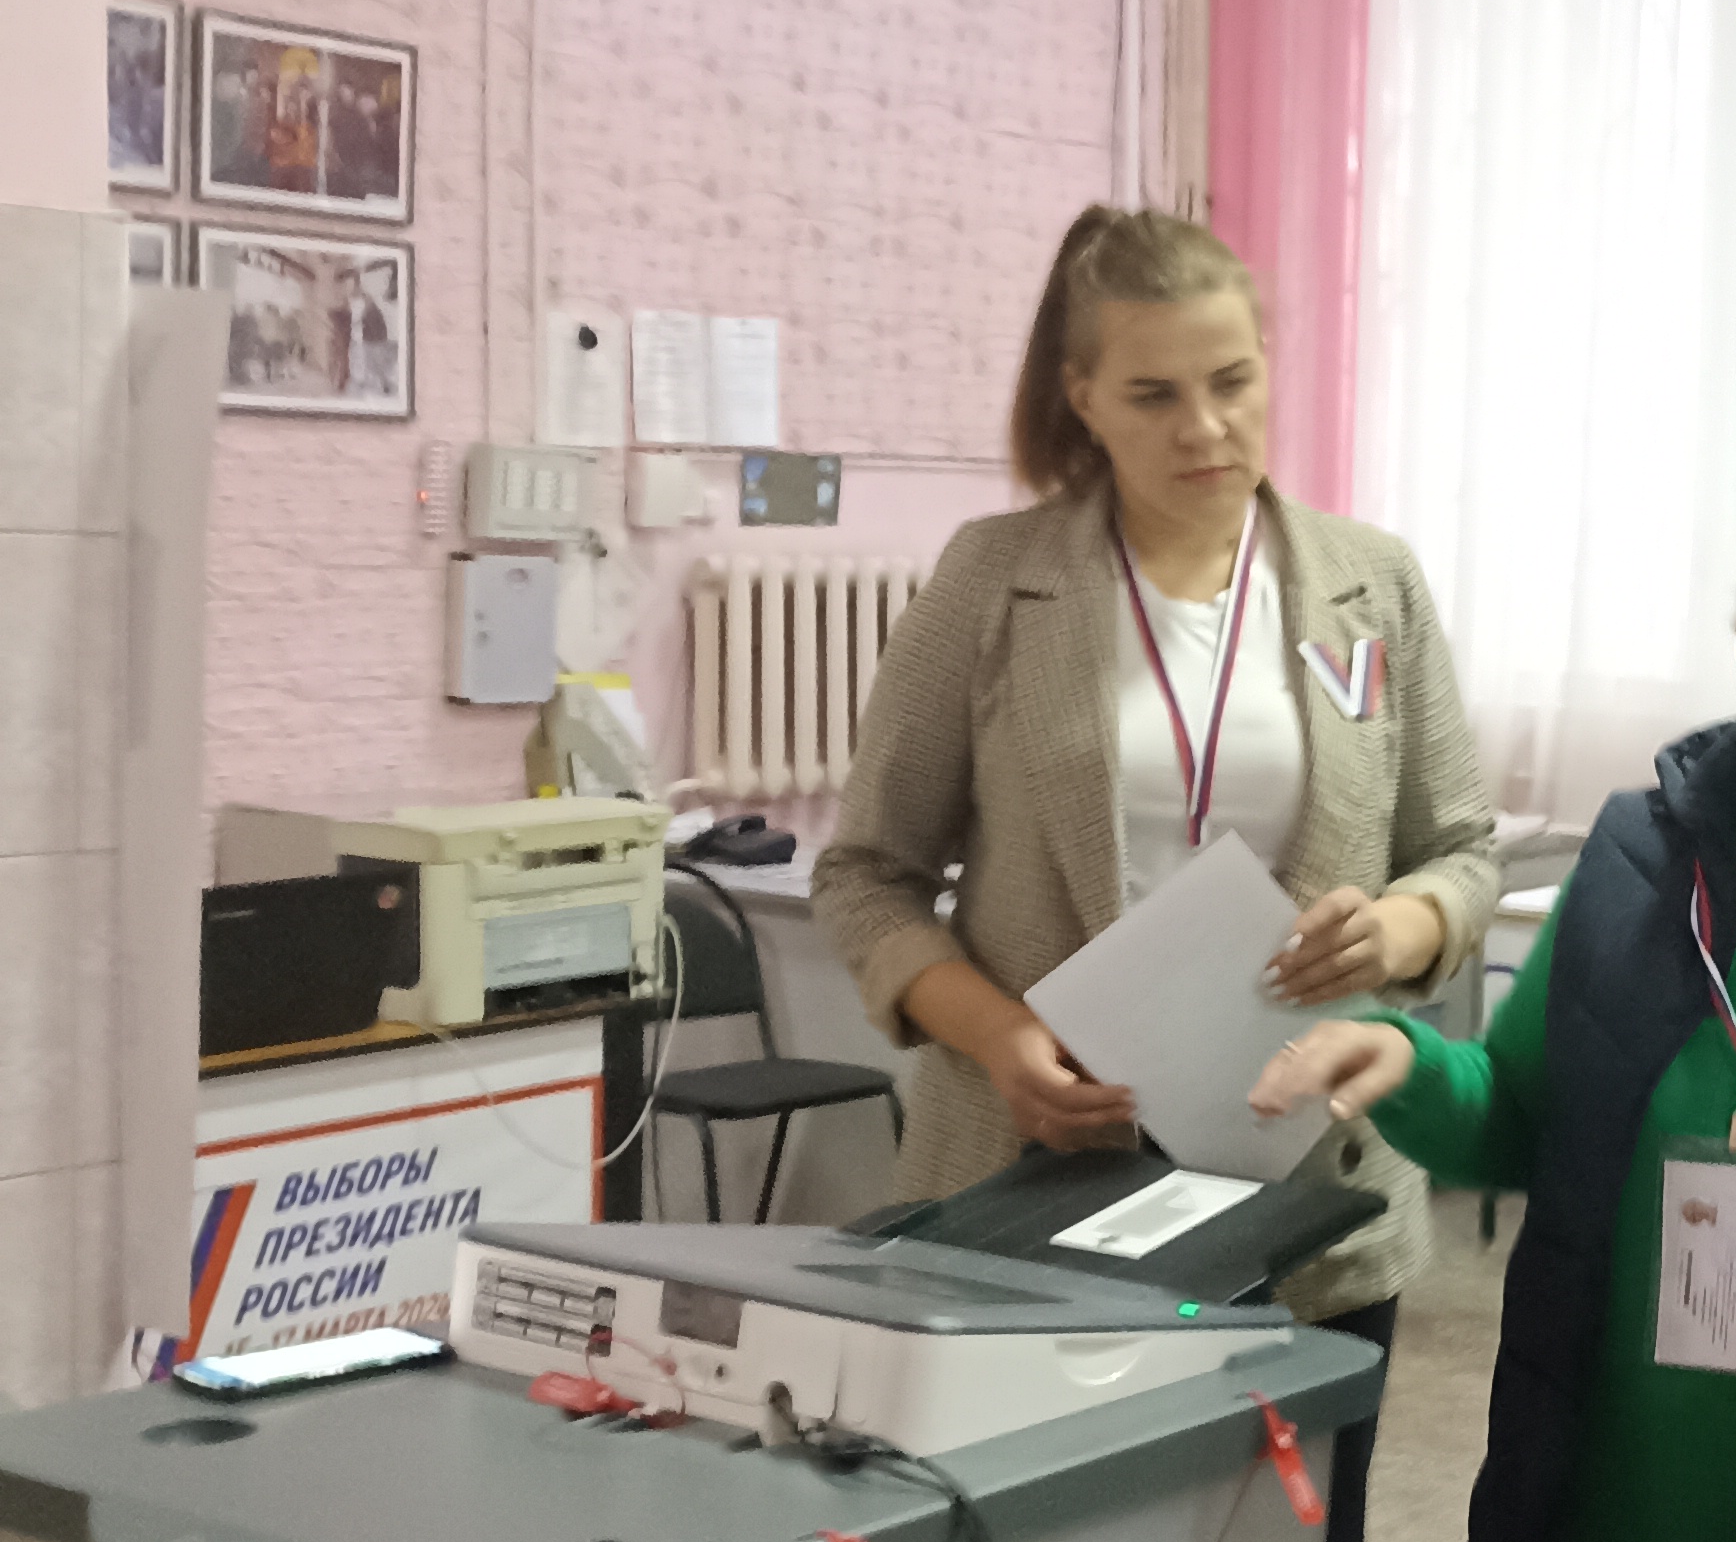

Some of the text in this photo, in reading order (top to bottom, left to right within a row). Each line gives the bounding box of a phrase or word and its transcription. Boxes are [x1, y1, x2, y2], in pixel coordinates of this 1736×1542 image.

[274, 1147, 438, 1213] ВЫБОРЫ
[254, 1186, 481, 1269] ПРЕЗИДЕНТА
[233, 1256, 388, 1326] РОССИИ
[302, 1305, 387, 1341] МАРТА
